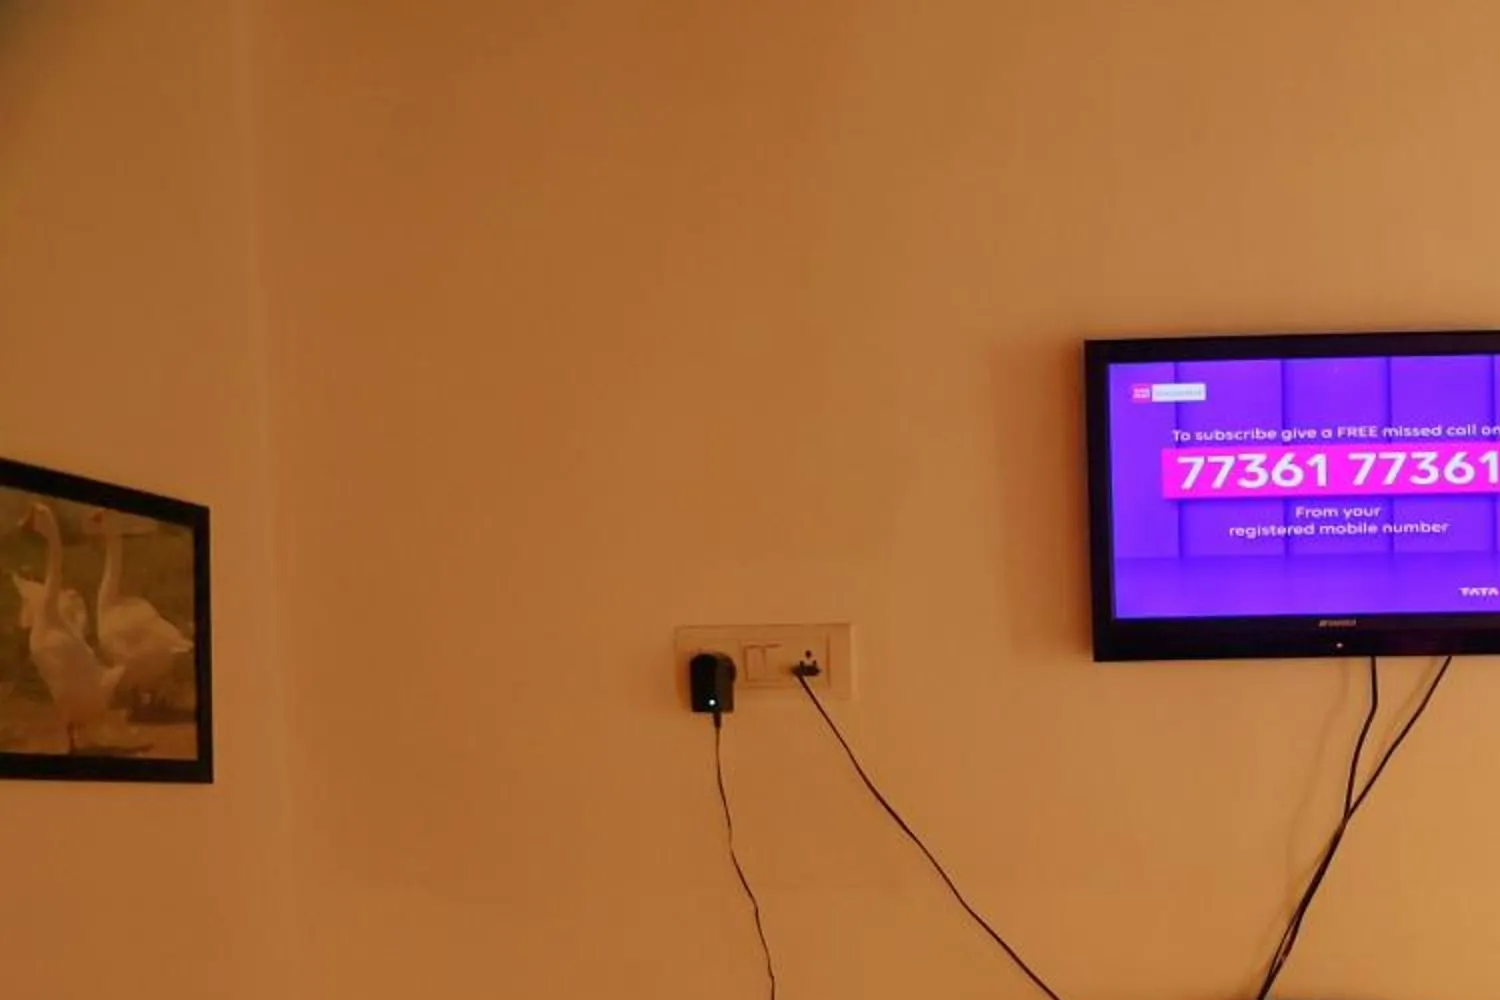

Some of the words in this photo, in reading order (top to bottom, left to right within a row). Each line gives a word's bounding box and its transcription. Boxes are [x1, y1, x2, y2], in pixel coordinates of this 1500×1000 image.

[1172, 428, 1190, 441] To
[1194, 427, 1277, 441] subscribe
[1281, 427, 1317, 442] give
[1321, 429, 1332, 439] a
[1337, 425, 1378, 438] FREE
[1383, 424, 1442, 437] missed
[1446, 423, 1477, 436] call
[1177, 452, 1328, 490] 77361
[1347, 450, 1500, 487] 77361
[1295, 506, 1339, 519] From
[1342, 506, 1382, 520] your
[1229, 523, 1315, 539] registered
[1319, 521, 1378, 535] mobile
[1382, 520, 1449, 534] number
[1458, 586, 1499, 598] TATA
